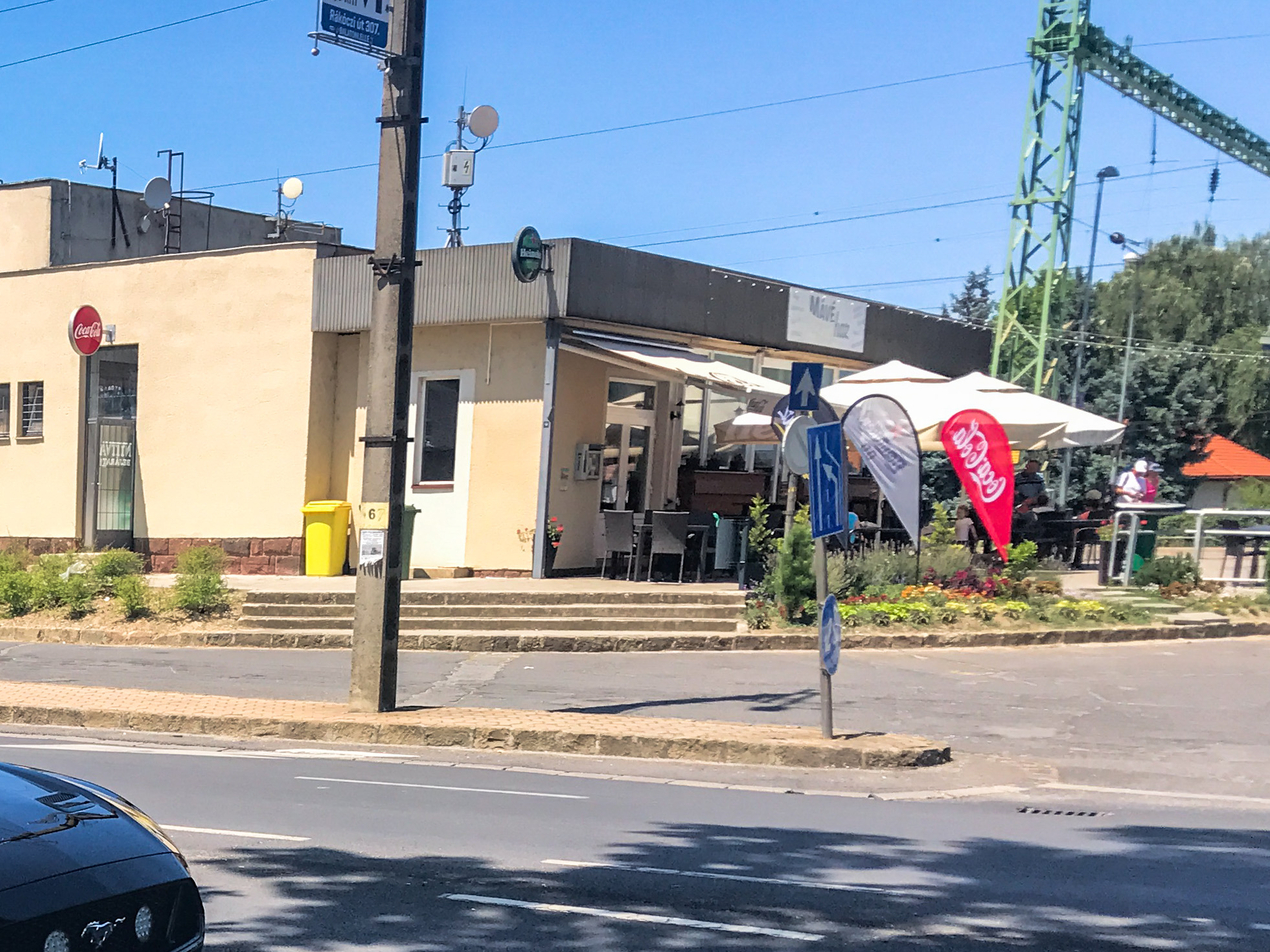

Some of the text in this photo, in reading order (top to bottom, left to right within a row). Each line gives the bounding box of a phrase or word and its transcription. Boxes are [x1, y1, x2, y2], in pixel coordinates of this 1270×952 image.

[329, 8, 380, 36] Rákóczi út 307.
